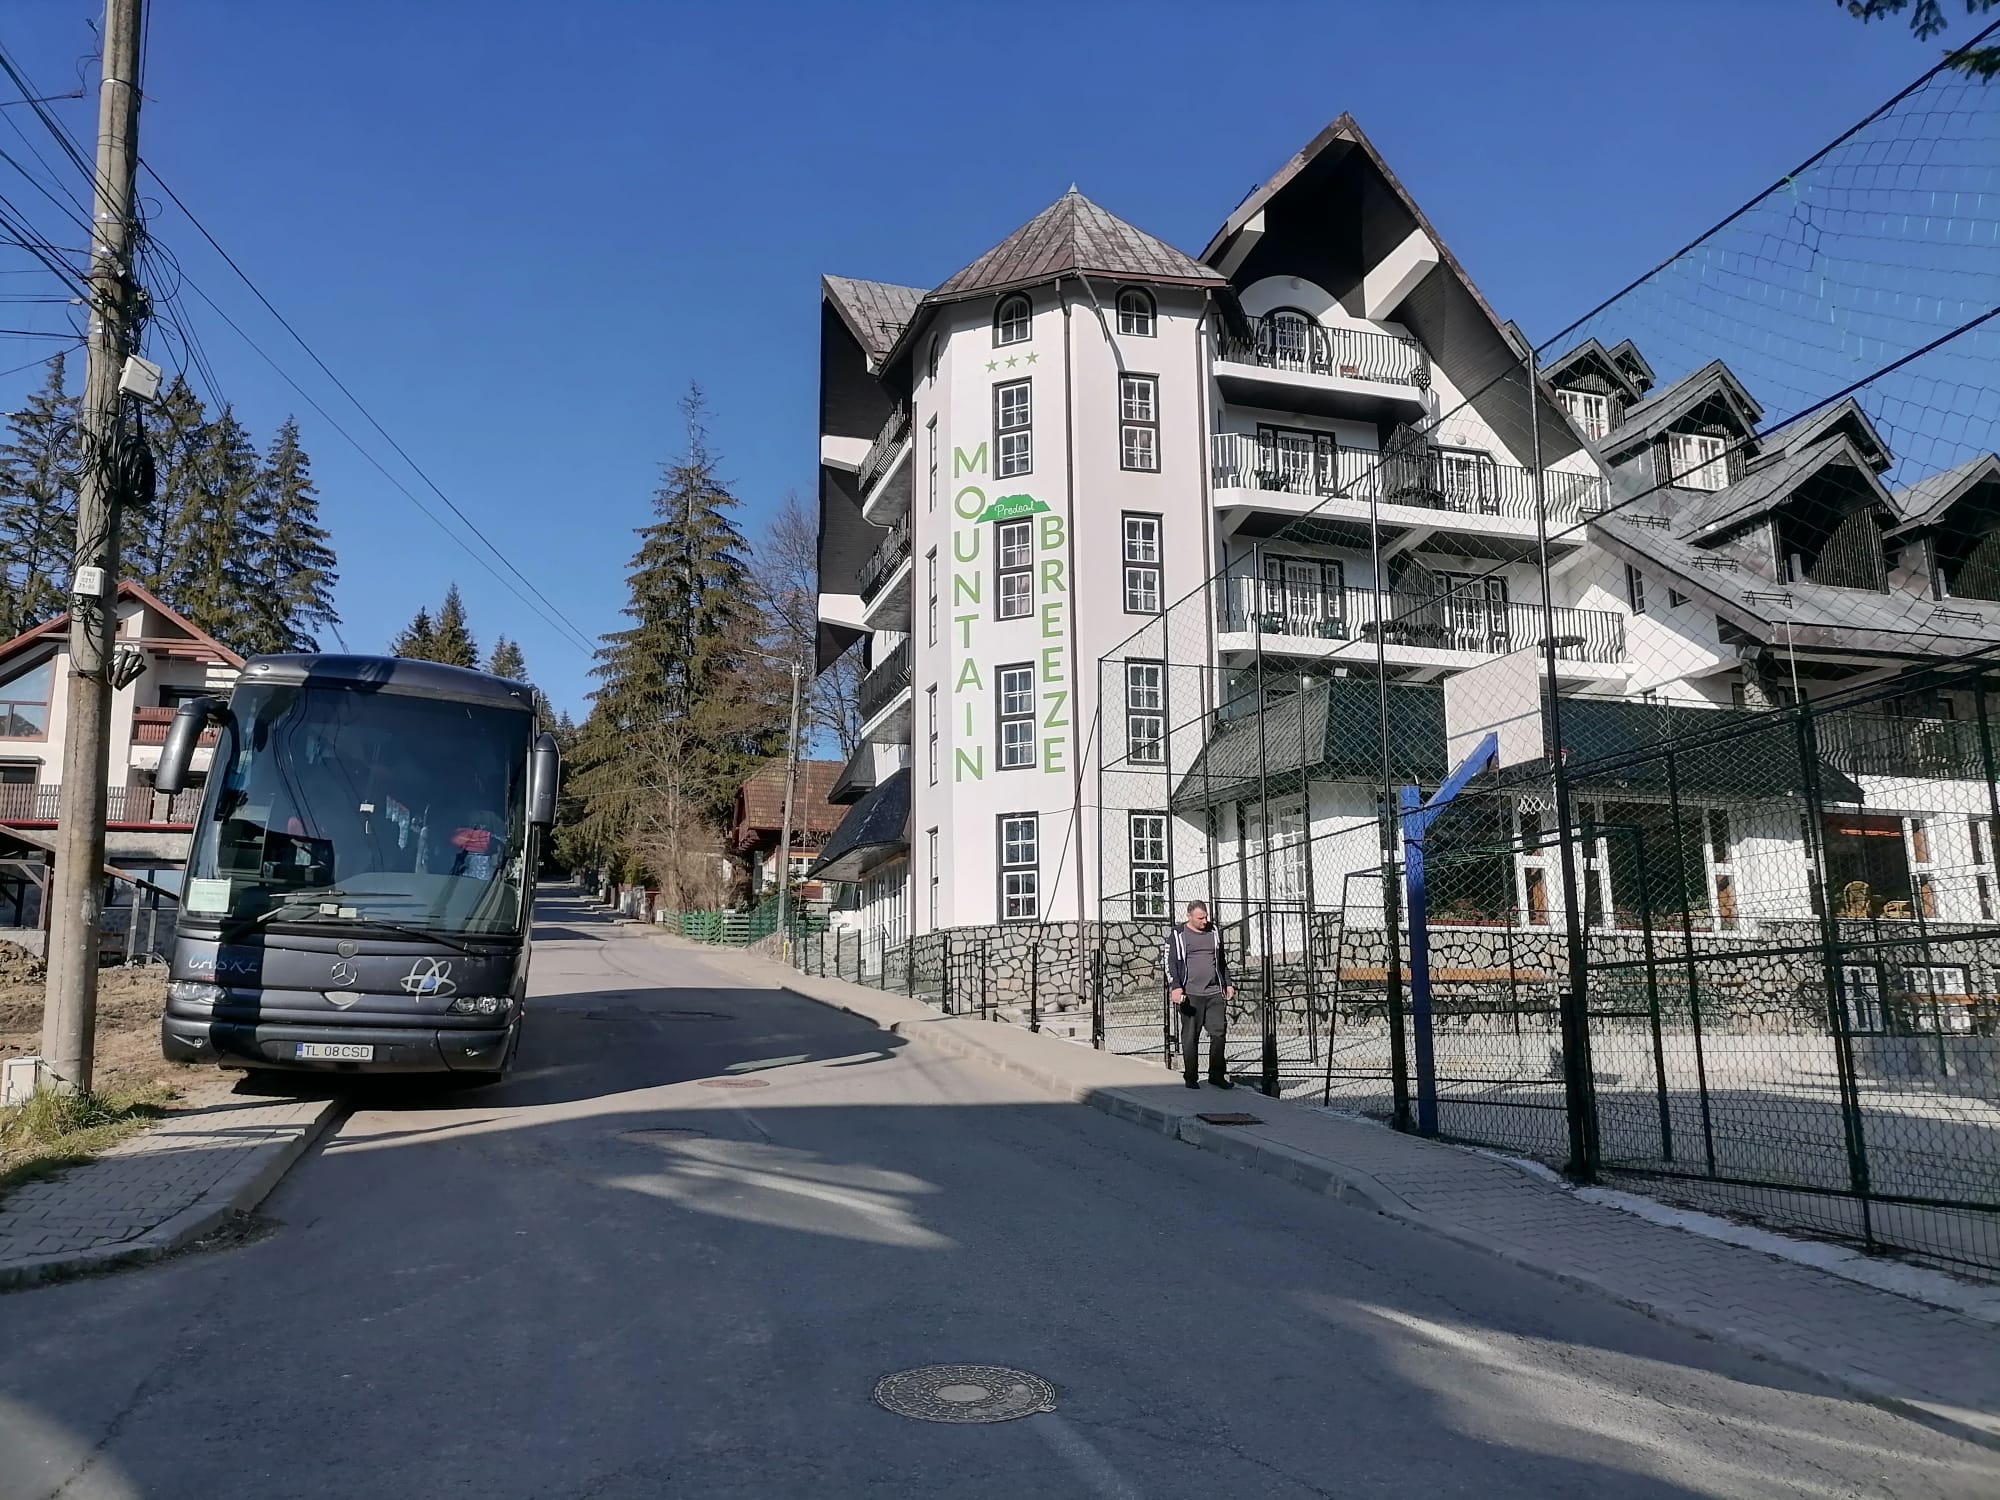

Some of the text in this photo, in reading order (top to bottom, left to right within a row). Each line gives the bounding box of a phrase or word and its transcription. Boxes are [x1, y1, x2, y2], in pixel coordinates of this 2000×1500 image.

[994, 500, 1035, 517] Predeal
[953, 441, 988, 783] MOUNTAIN
[1039, 515, 1069, 774] BREEZE
[304, 1044, 370, 1058] TL 08 CSD
